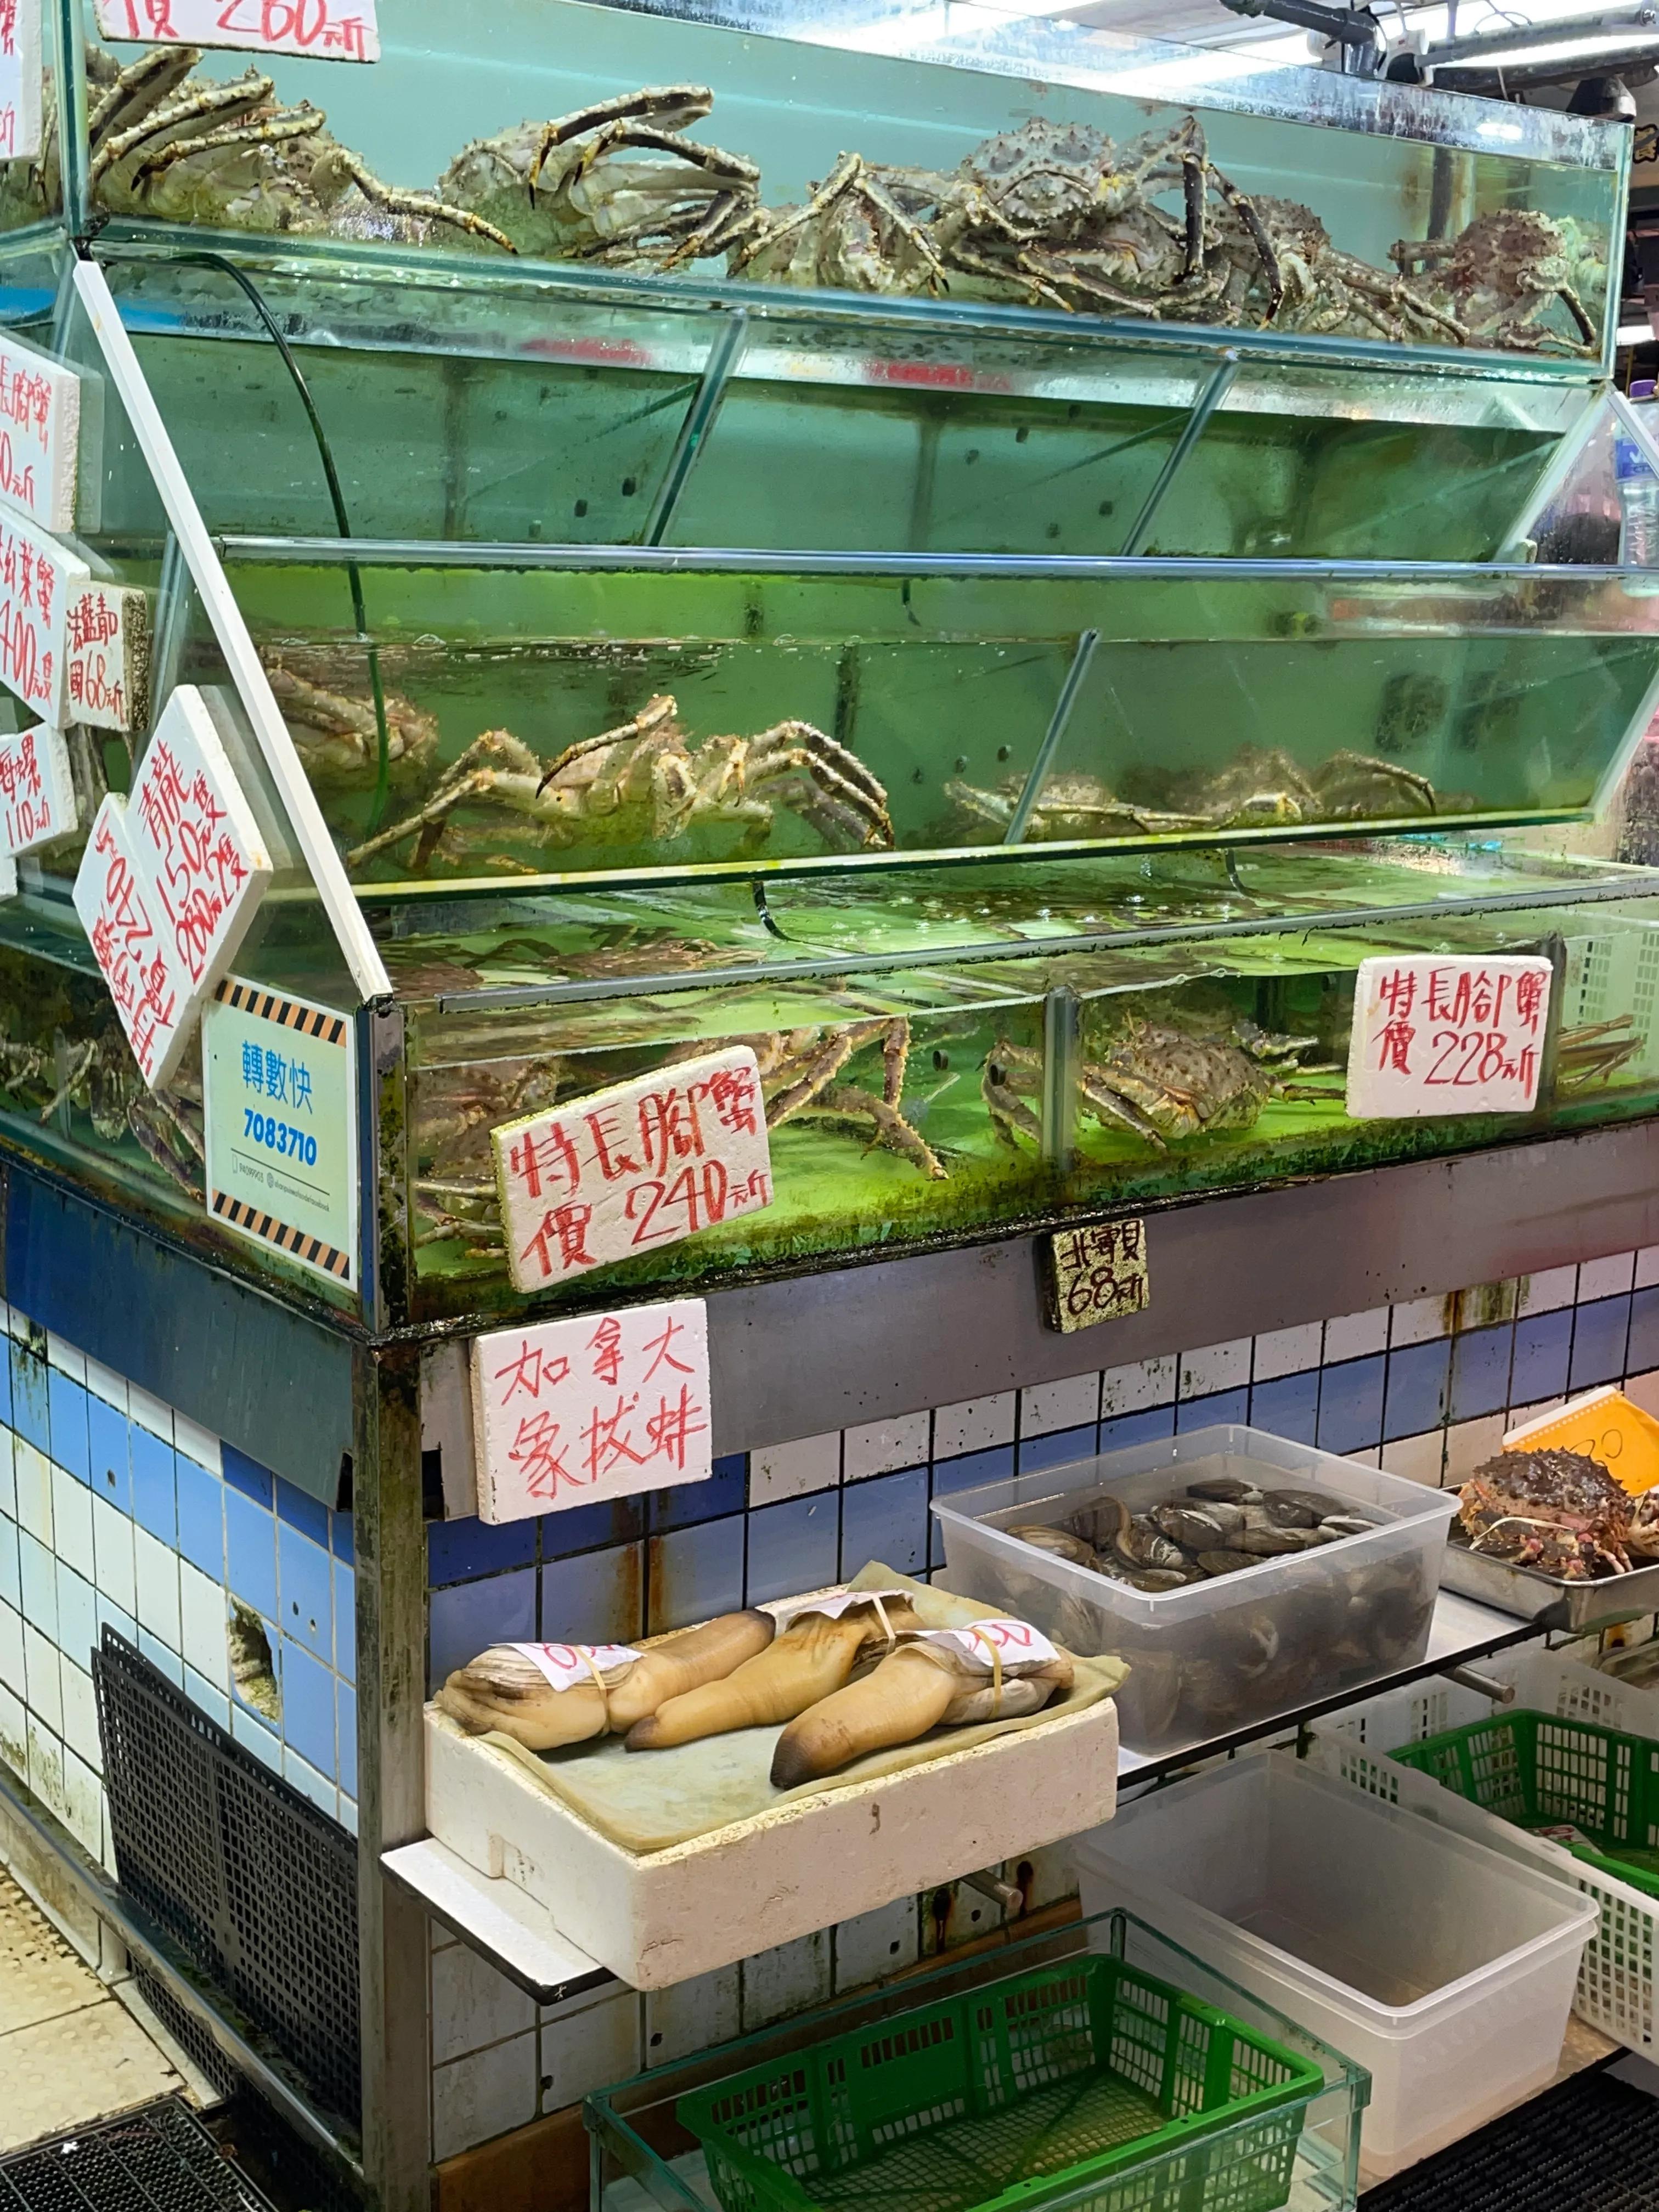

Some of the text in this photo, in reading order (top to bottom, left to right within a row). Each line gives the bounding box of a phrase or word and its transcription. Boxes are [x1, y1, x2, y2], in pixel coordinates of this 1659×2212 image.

[242, 1040, 313, 1115] 轉數快
[244, 1108, 317, 1166] 7083710
[495, 1316, 695, 1406] 加拿大
[507, 1383, 708, 1500] 象拔蚌
